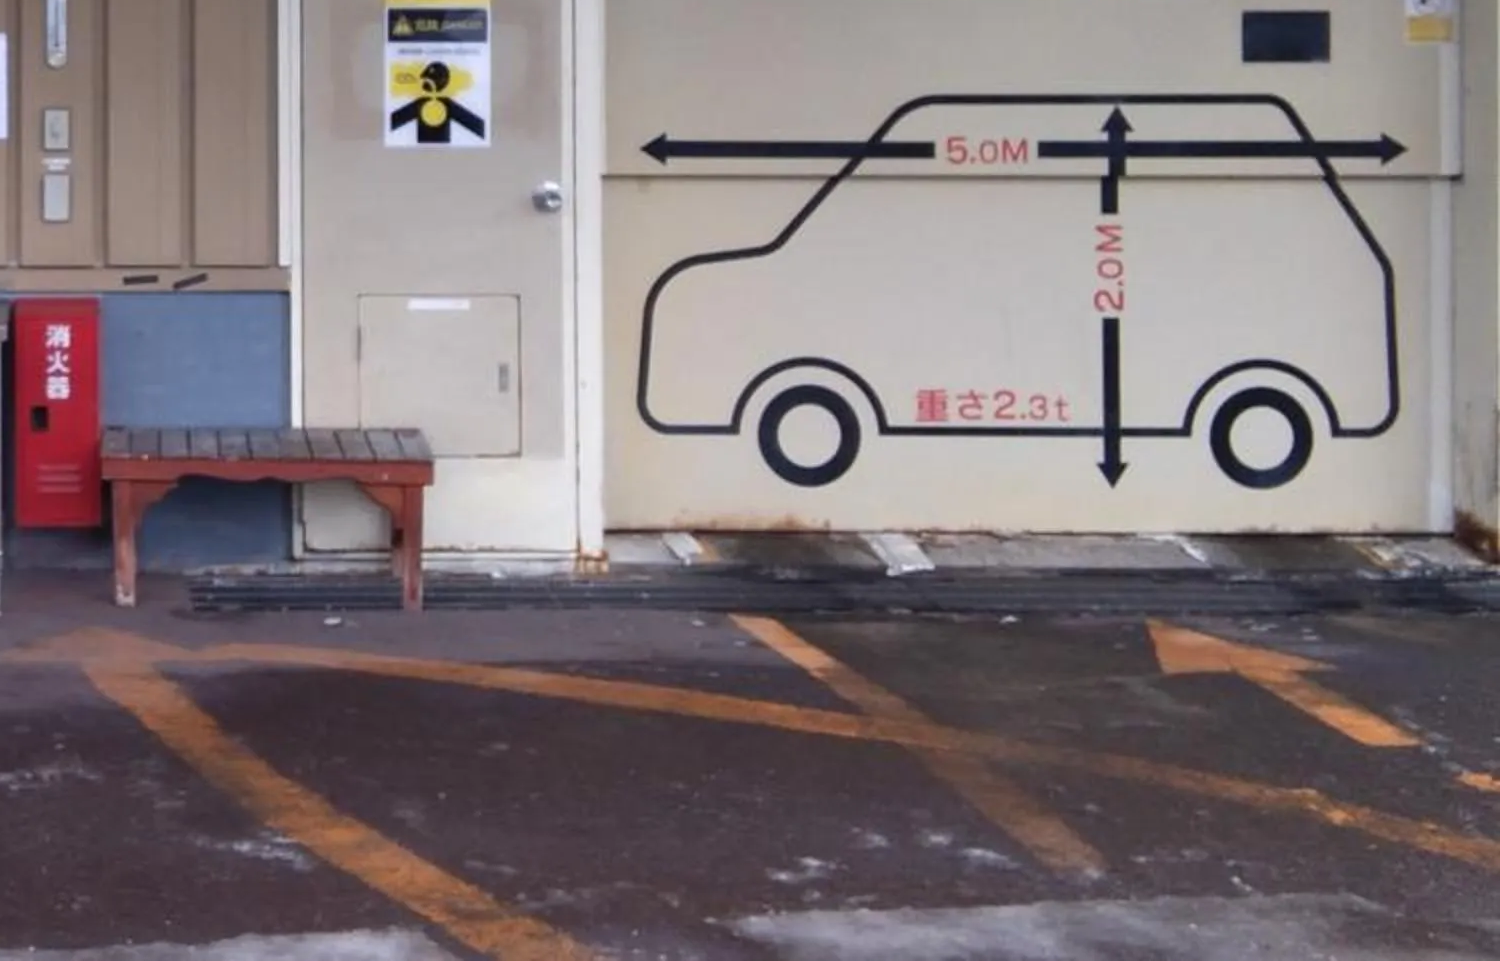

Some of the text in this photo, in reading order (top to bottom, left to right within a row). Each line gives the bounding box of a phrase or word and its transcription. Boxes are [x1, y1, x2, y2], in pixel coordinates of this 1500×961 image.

[945, 135, 1030, 165] 5.0M
[1094, 223, 1125, 312] 2.0M
[45, 323, 72, 400] 消火器
